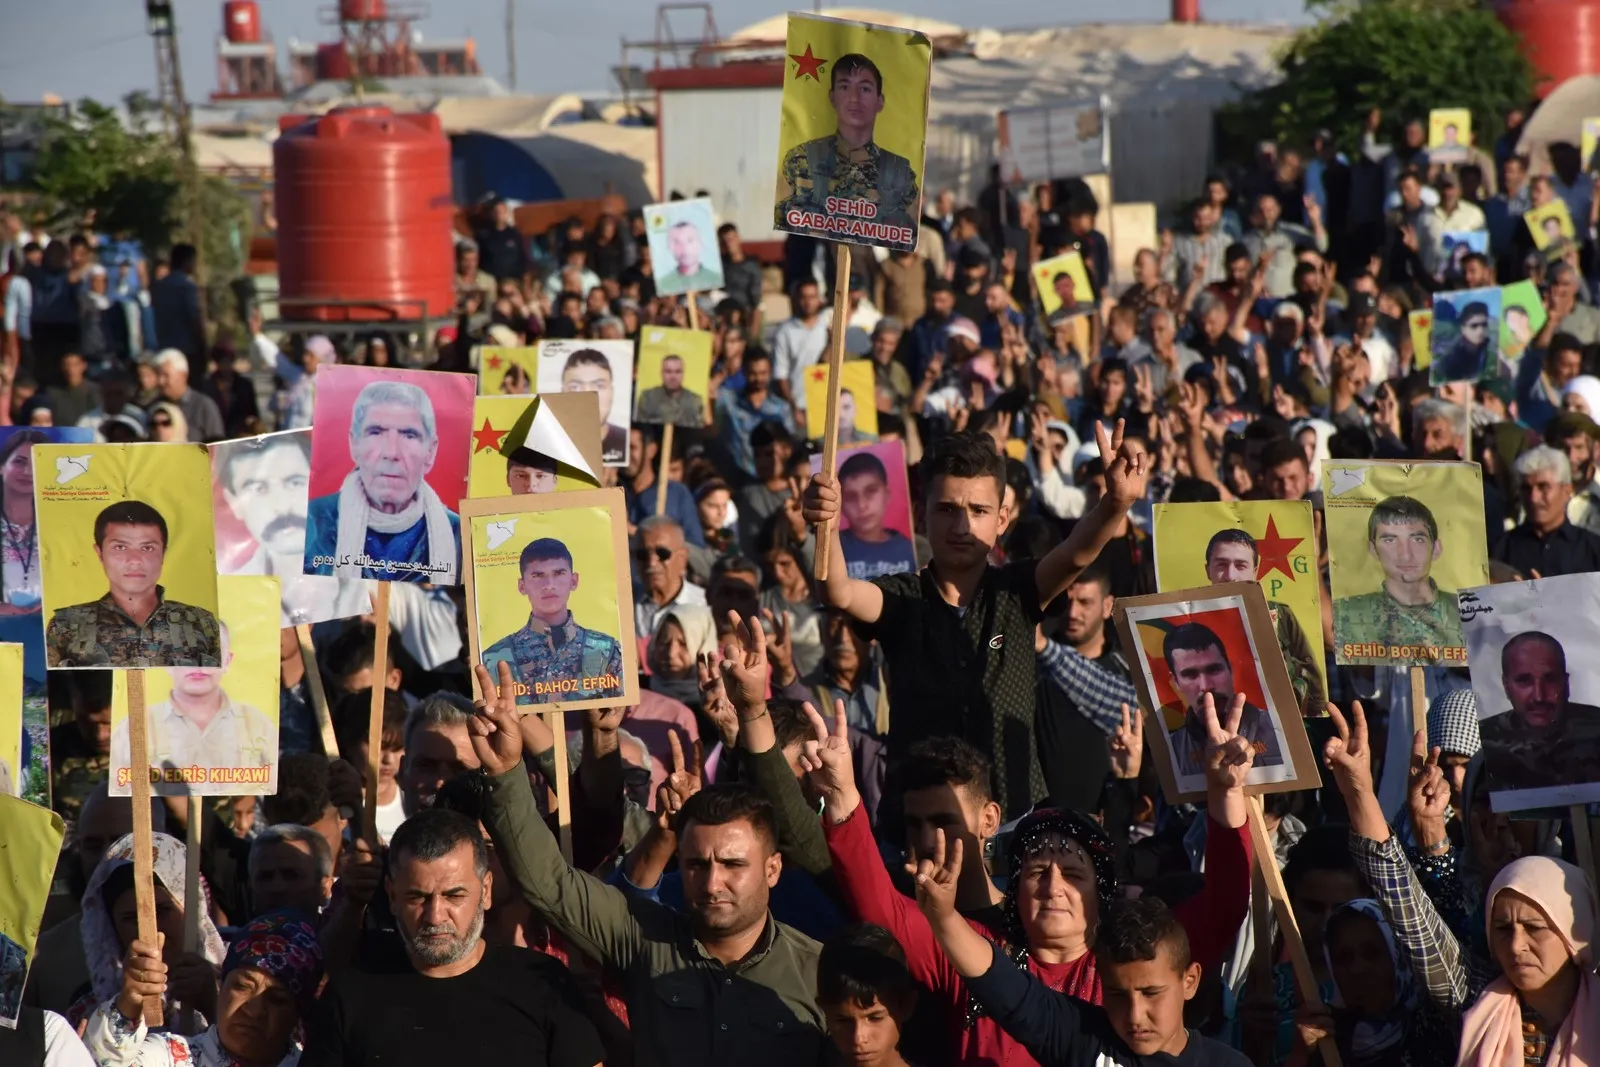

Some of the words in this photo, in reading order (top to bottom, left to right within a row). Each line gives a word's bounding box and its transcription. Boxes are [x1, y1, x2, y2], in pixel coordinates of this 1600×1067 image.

[826, 196, 877, 218] ŞEHÎD
[787, 210, 850, 234] GABAR
[850, 221, 913, 243] AMUDE
[1343, 642, 1387, 660] ŞEHÎD
[1391, 644, 1439, 660] BOTAN
[535, 679, 579, 694] BAHOZ
[582, 673, 620, 690] EFRÎN
[164, 765, 207, 783] EDRÎS
[209, 765, 270, 783] KILKAWÎ
